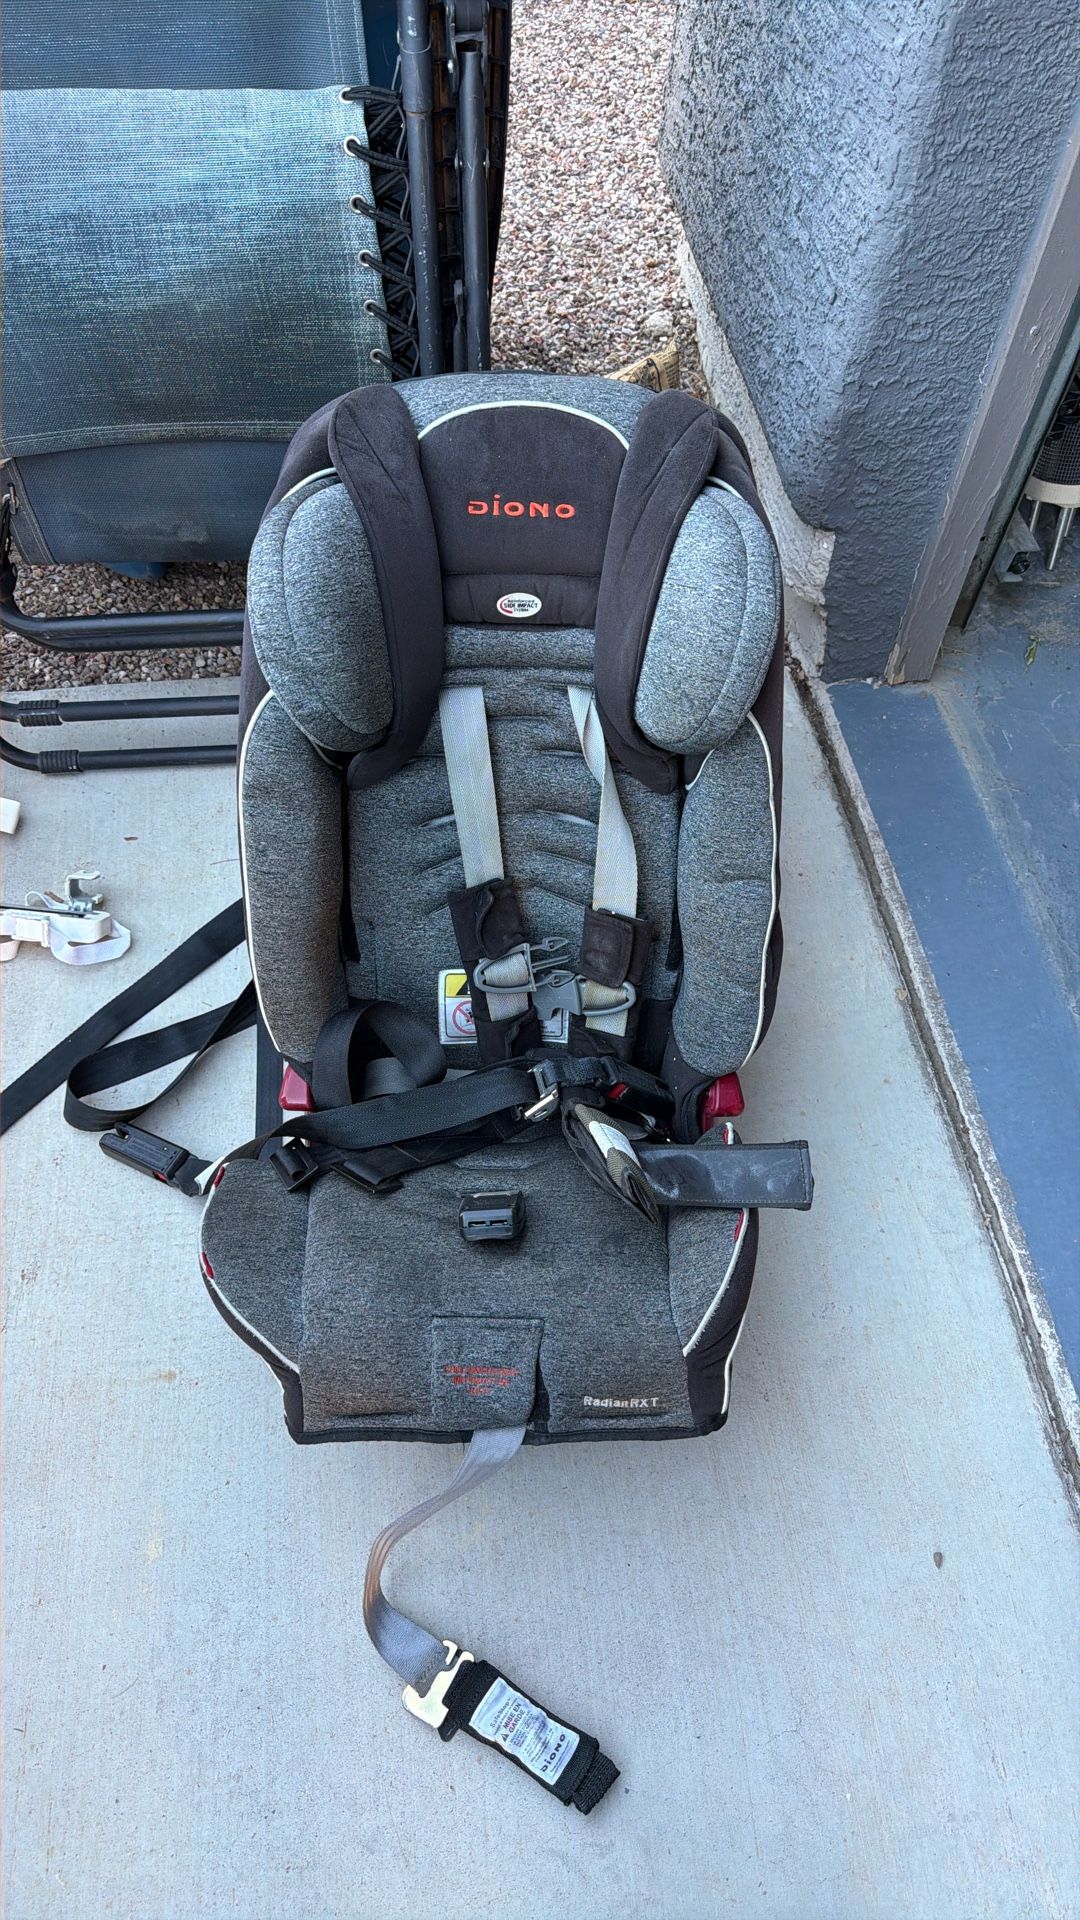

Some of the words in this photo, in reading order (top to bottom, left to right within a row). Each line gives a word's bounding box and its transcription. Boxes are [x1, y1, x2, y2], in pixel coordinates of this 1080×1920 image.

[502, 1712, 516, 1730] MISE
[513, 1702, 522, 1713] EN
[508, 1709, 526, 1733] GARDE
